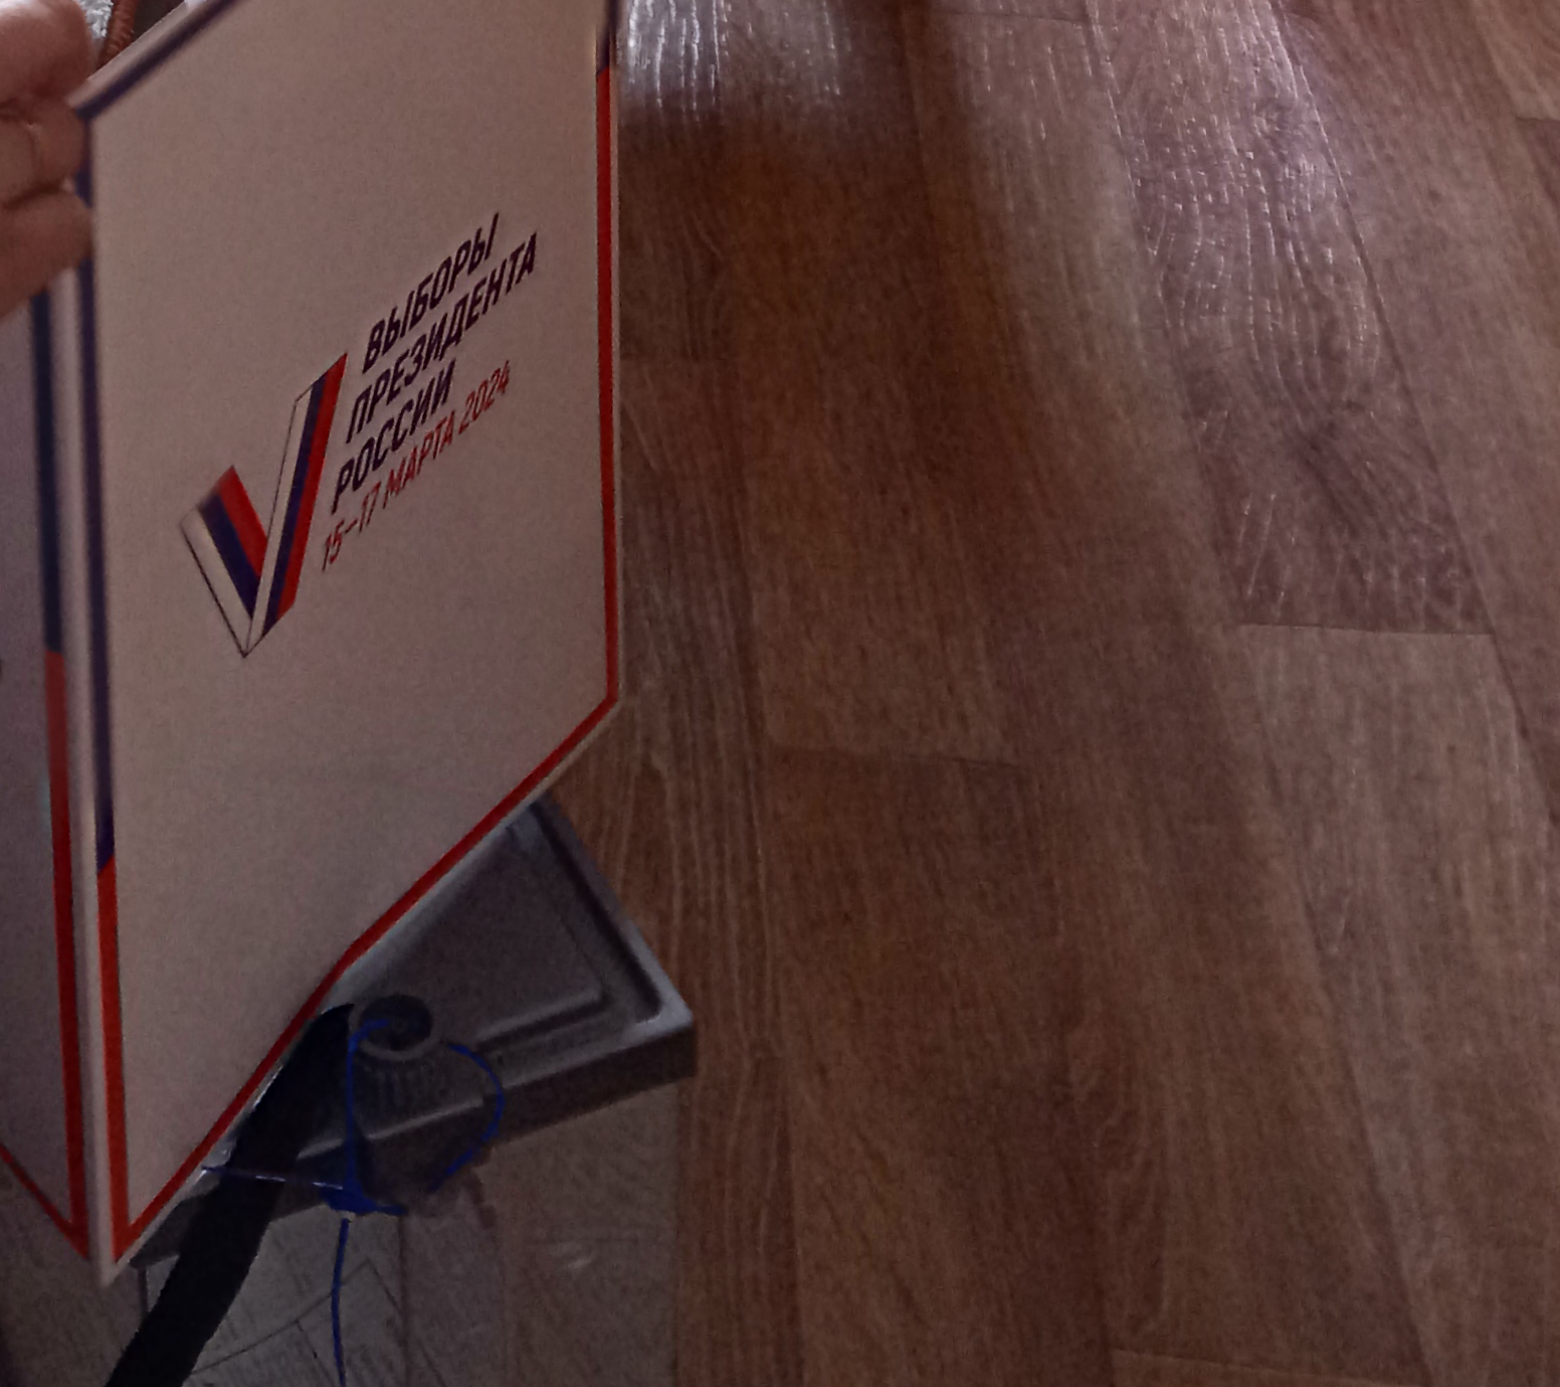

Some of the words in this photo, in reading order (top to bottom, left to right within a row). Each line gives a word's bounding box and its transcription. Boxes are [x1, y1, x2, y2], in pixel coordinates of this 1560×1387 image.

[345, 231, 538, 444] ПРЕЗИДЕНТА
[361, 212, 500, 374] ВЫБОРЫ
[330, 357, 456, 515] РОССИИ
[382, 409, 457, 510] МАРТА
[458, 359, 511, 435] 2024
